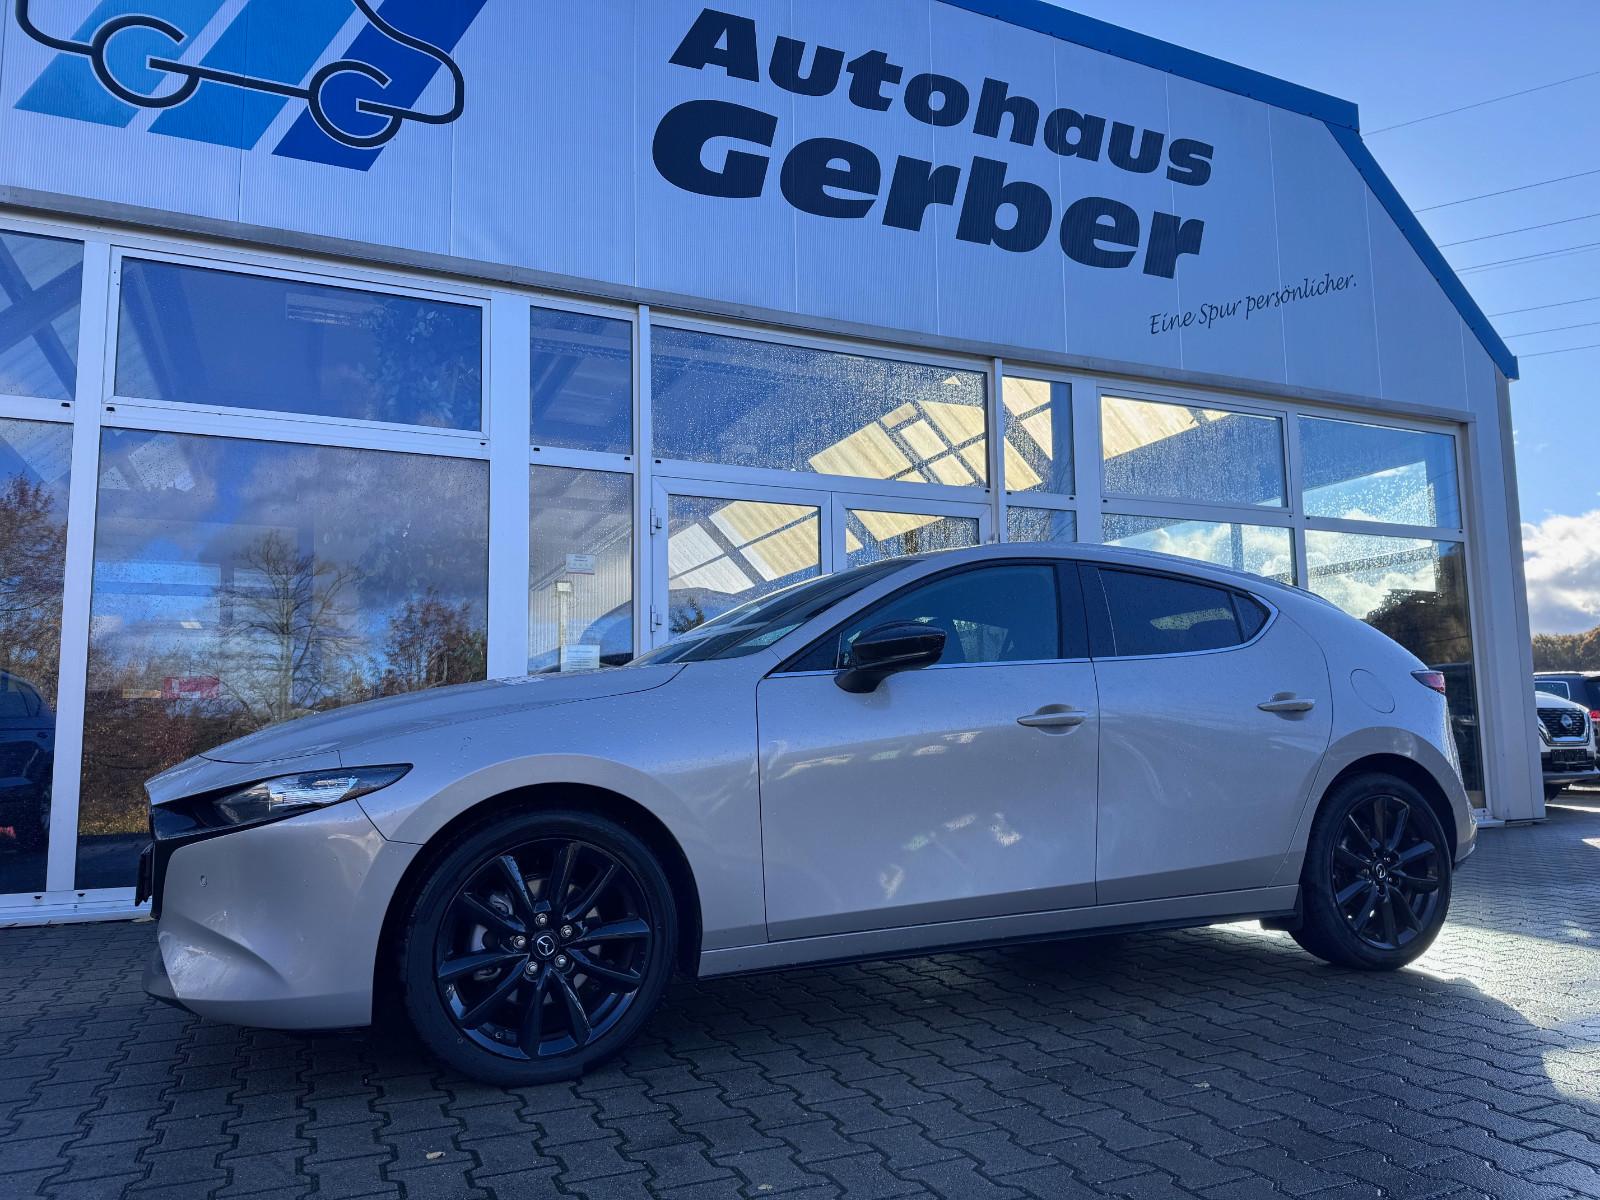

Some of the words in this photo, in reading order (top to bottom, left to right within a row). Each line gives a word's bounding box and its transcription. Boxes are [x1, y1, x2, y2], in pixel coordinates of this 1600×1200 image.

[668, 8, 1214, 187] Autohaus
[652, 99, 1205, 280] Gerber
[1149, 311, 1197, 335] Eine
[1198, 299, 1242, 329] Spur
[1245, 273, 1358, 321] persönlicher.
